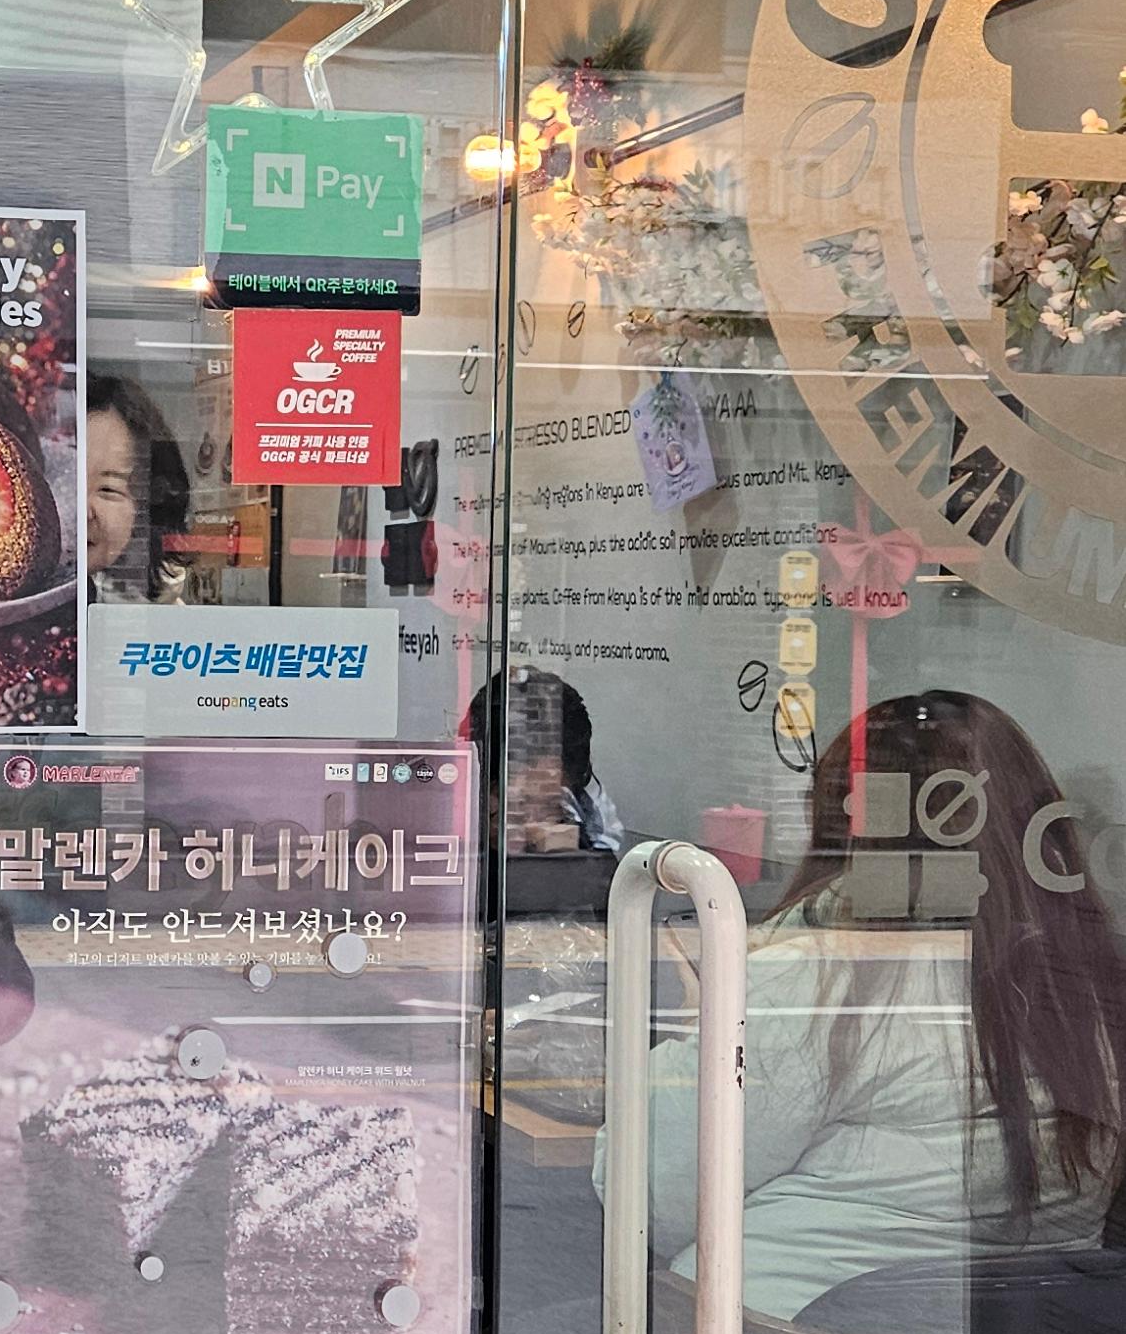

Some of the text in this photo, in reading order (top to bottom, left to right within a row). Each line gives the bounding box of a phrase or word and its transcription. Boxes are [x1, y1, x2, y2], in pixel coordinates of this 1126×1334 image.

[317, 165, 384, 210] Pay
[228, 273, 399, 296] 테이블에서 QR주문하세요
[333, 341, 385, 351] SPECIALTY
[335, 329, 381, 340] PREMIUM
[341, 352, 377, 363] COFFEE
[276, 388, 355, 415] OGCR
[572, 410, 632, 440] BLENDED
[258, 435, 369, 448] 프리미엄 커피 사용 인증
[260, 450, 296, 463] OGCR
[298, 450, 321, 464] 공식
[585, 482, 595, 501] in
[596, 481, 624, 505] Kenya
[627, 481, 644, 498] are
[743, 463, 786, 487] around
[589, 534, 606, 558] plus
[609, 534, 625, 552] the
[628, 530, 657, 552] acidic
[660, 529, 675, 551] soil
[679, 528, 719, 556] provide
[722, 526, 770, 548] excellent
[774, 522, 838, 545] conditions
[553, 587, 581, 606] Coffee
[583, 587, 605, 606] from
[607, 587, 637, 611] Kenya
[640, 586, 648, 606] is
[650, 586, 662, 606] of
[665, 586, 682, 606] the
[822, 584, 833, 607] is
[837, 586, 859, 607] well
[864, 585, 908, 608] known
[398, 624, 440, 663] ffeeyah
[575, 639, 592, 657] and
[119, 642, 368, 679] 쿠팡이츠 배달맛집
[196, 694, 289, 711] coupang eats
[182, 827, 464, 892] 허니케이크
[51, 908, 409, 945] 아직도 안드셔보셨나요?
[223, 953, 237, 966] 수
